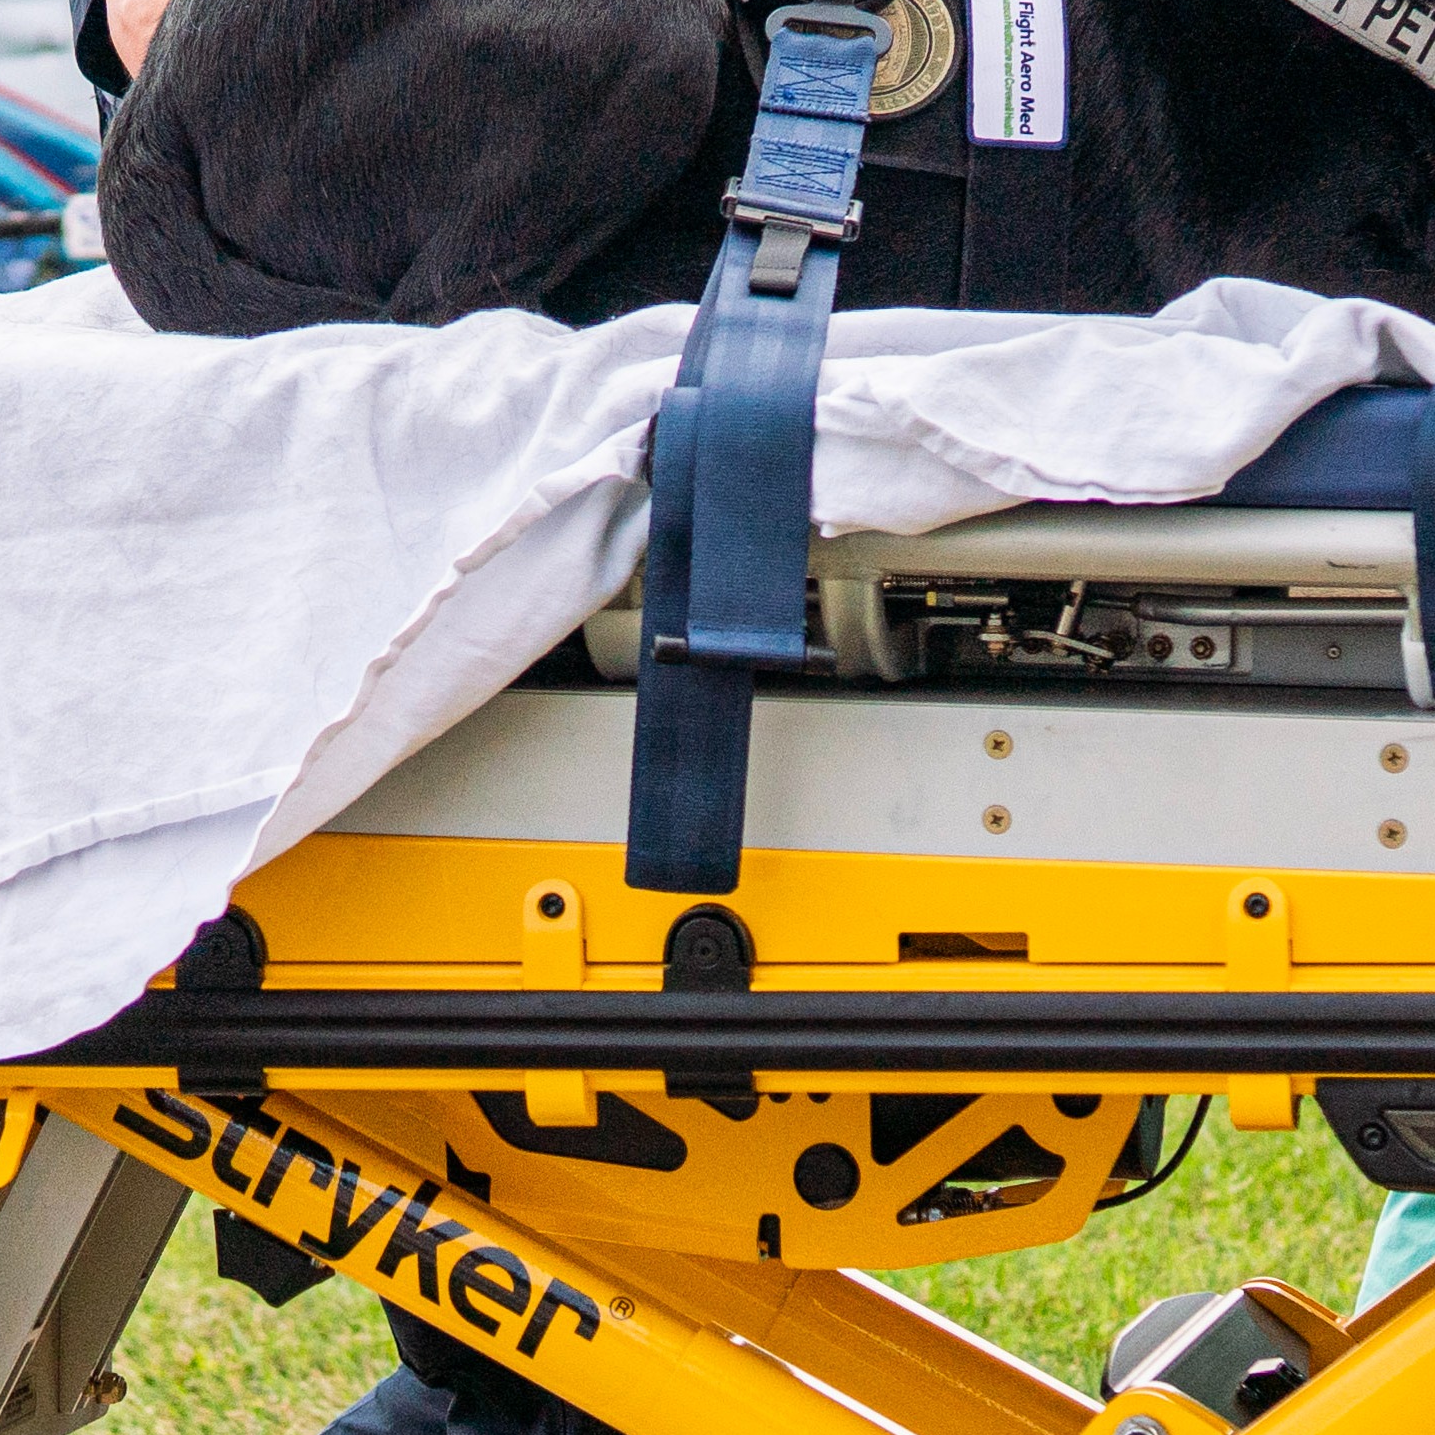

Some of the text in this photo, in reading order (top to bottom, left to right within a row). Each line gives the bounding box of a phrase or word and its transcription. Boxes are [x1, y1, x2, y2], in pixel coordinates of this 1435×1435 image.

[1015, 1, 1036, 47] Flight
[1020, 51, 1035, 92] Aero
[1019, 96, 1035, 135] Med
[113, 1088, 601, 1359] stryker
